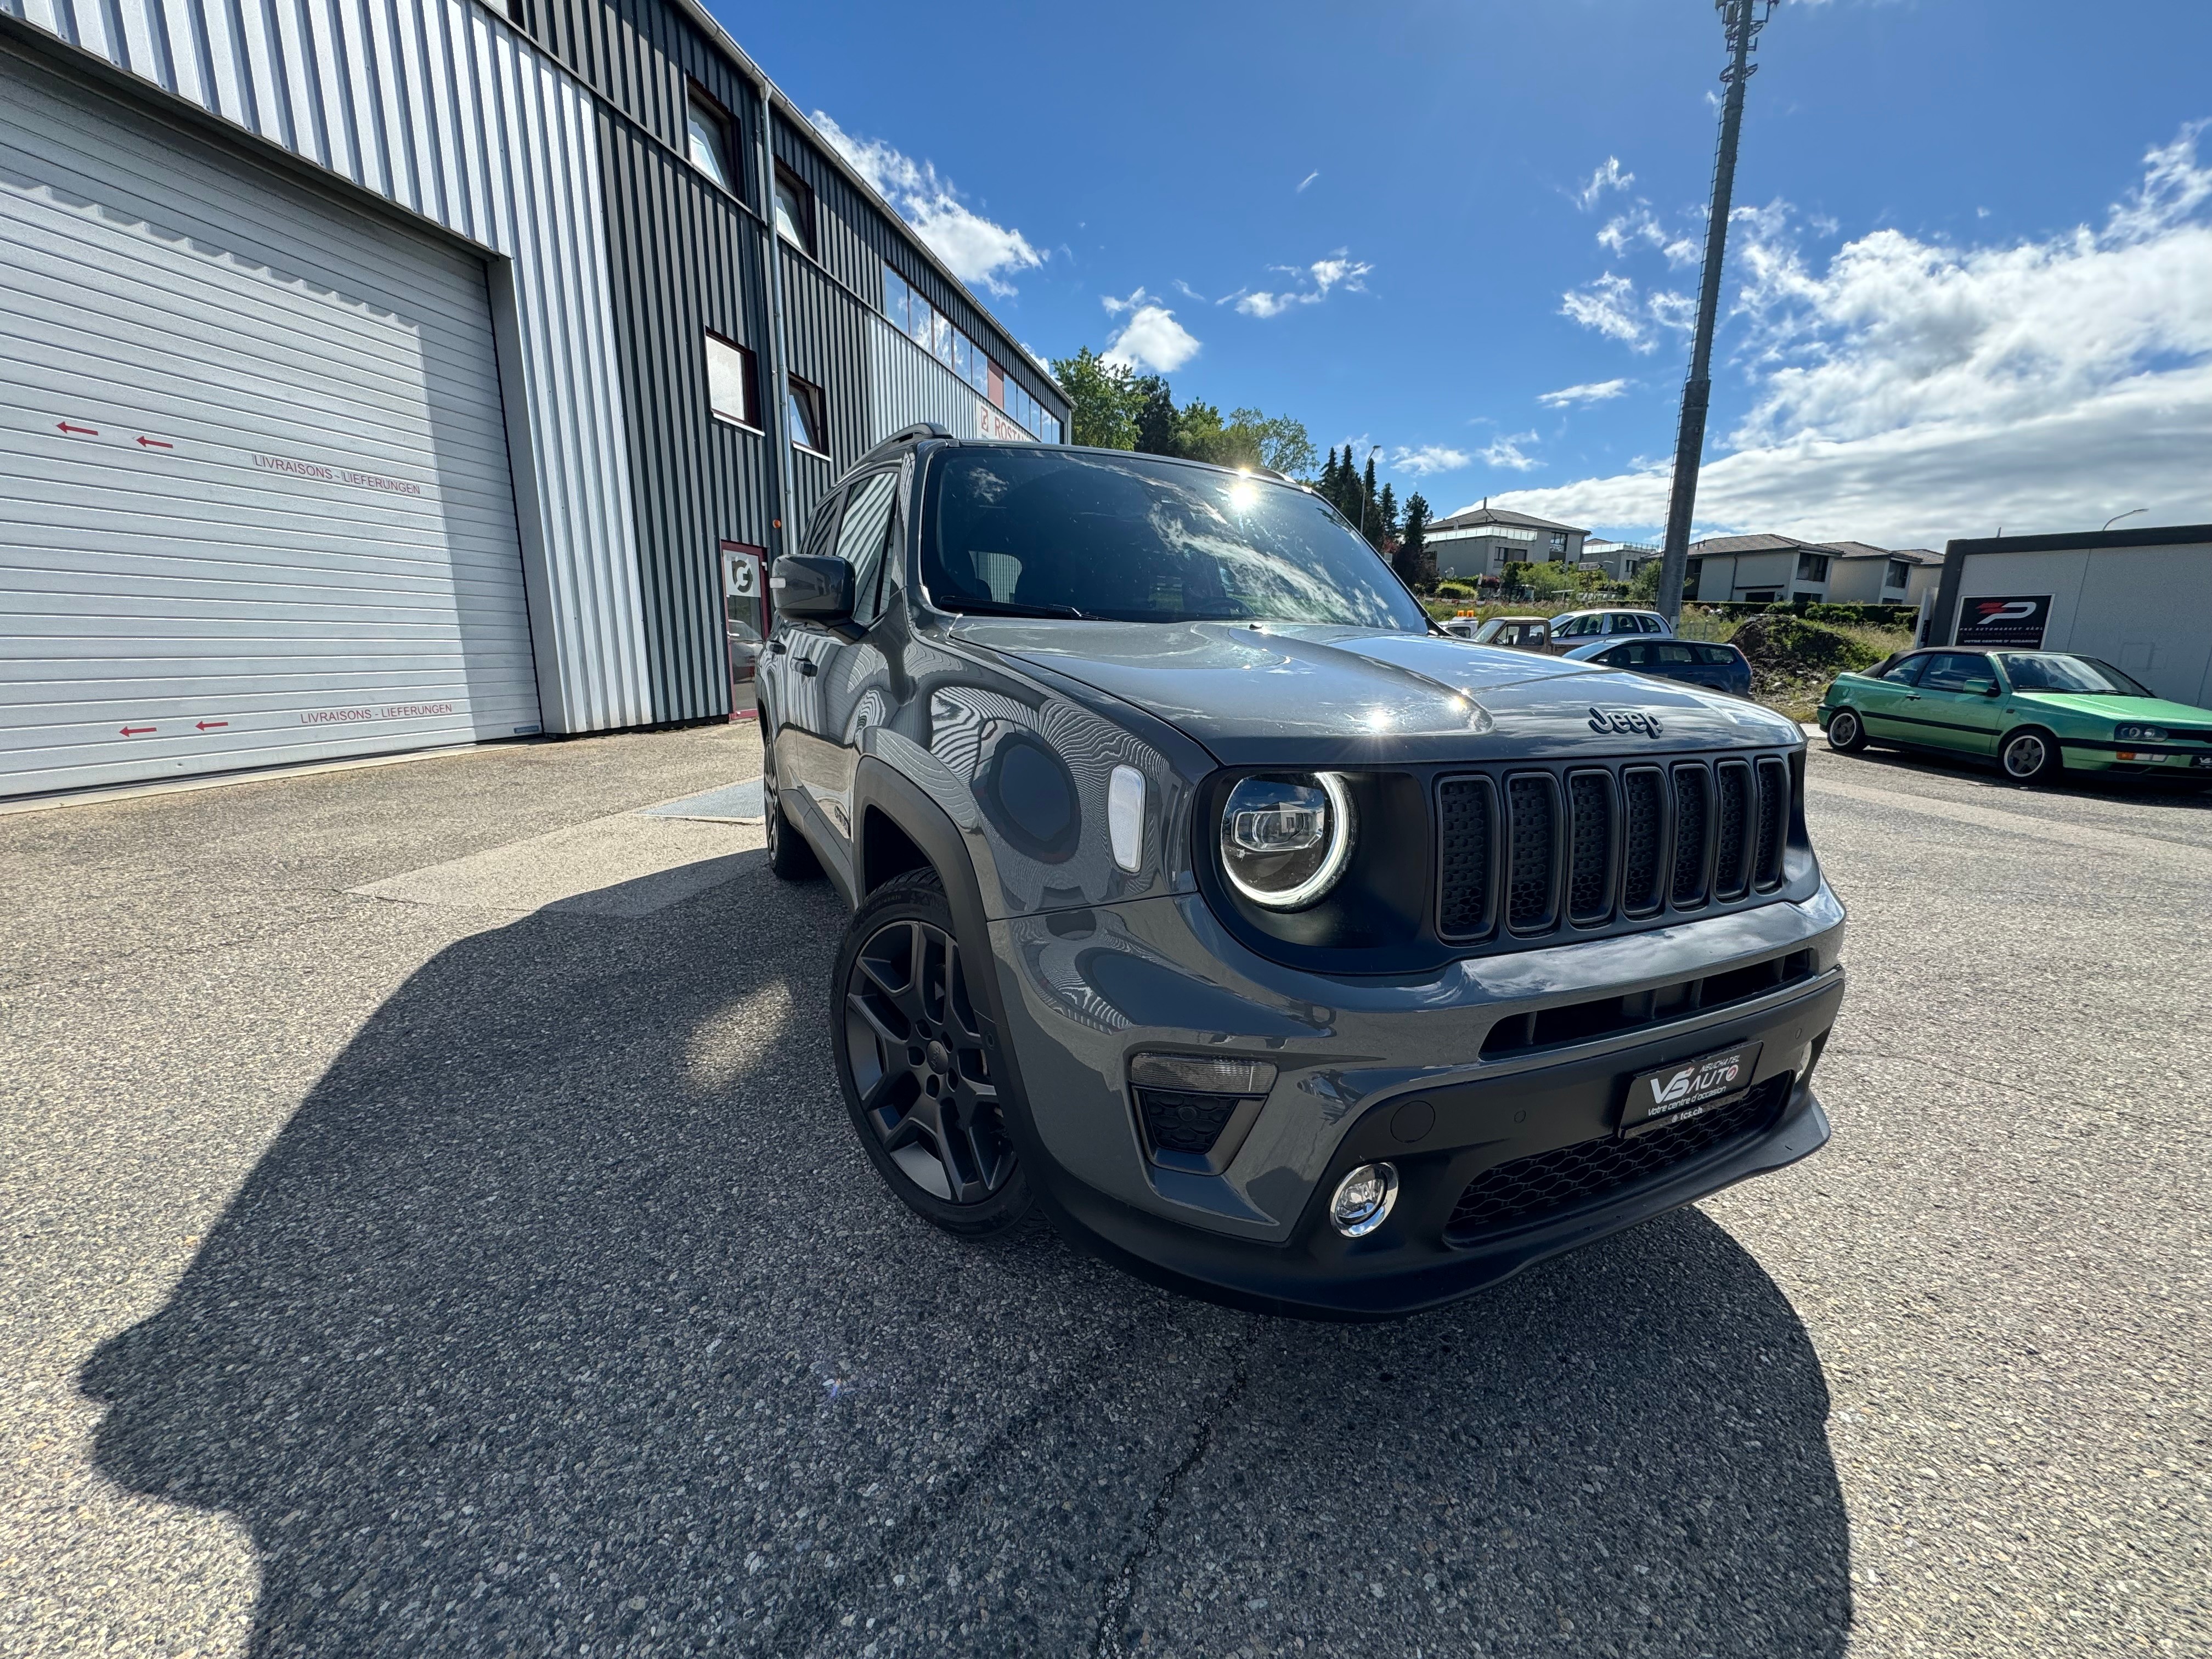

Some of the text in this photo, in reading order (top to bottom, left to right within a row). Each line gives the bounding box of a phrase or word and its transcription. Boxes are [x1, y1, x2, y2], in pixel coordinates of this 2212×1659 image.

[254, 454, 333, 479] LIVRAISONS
[342, 472, 421, 494] LIEFERUNGEN
[300, 709, 372, 723] LIVRAISONS
[381, 704, 452, 718] LIEFERUNGEN
[1588, 707, 1664, 739] Jeep
[1648, 1086, 1726, 1116] Votre centre d'occasion
[1680, 1107, 1703, 1120] tcs.ch
